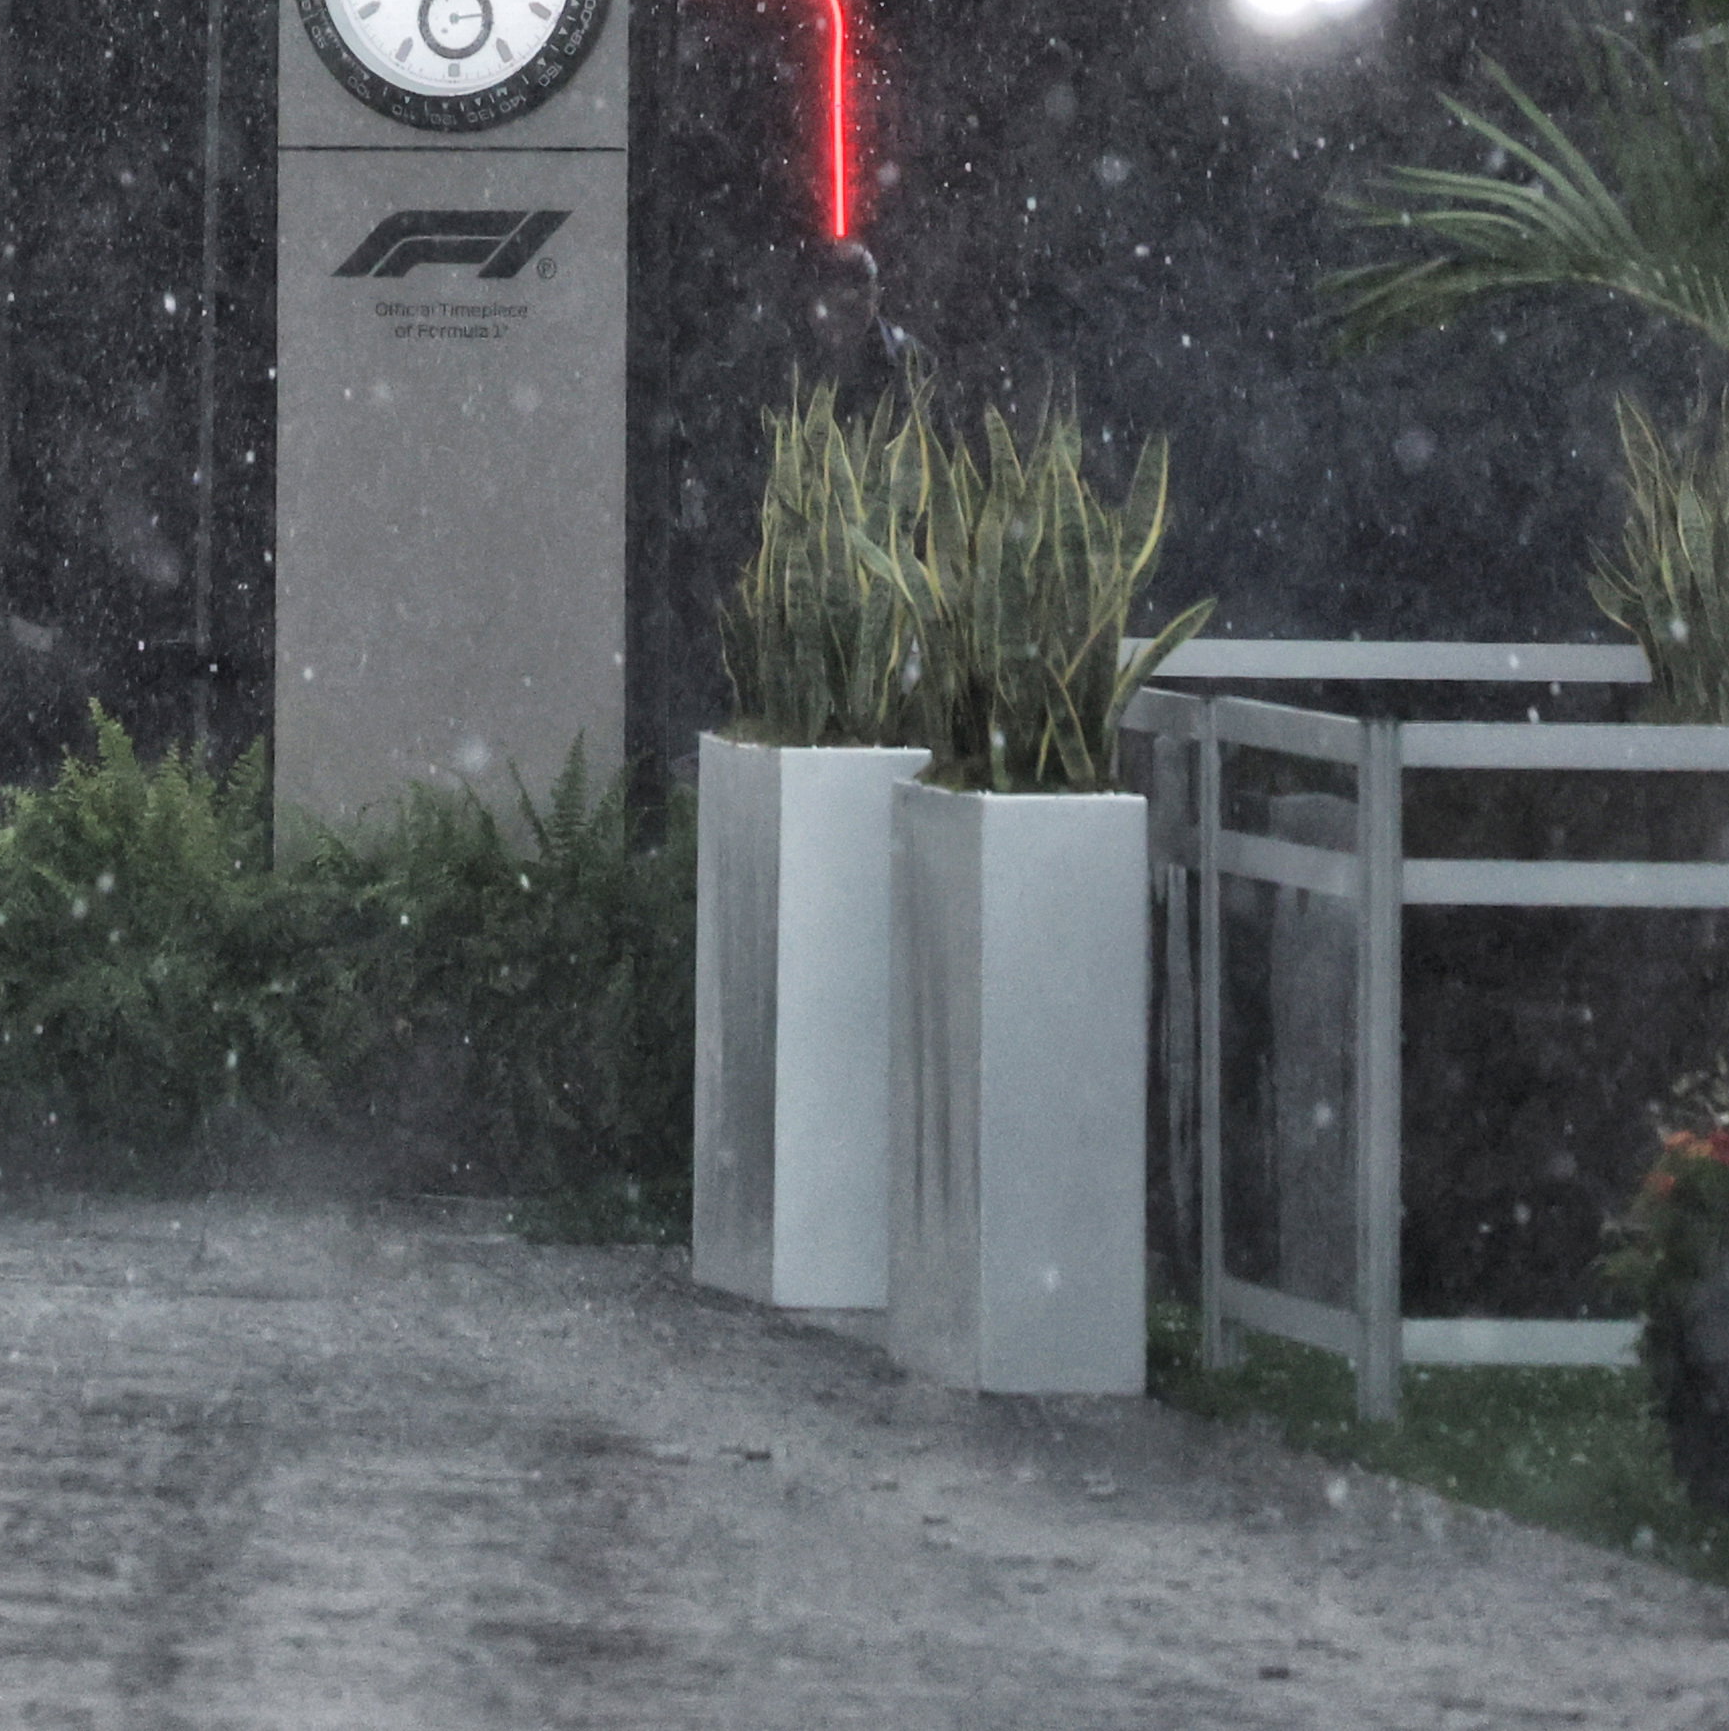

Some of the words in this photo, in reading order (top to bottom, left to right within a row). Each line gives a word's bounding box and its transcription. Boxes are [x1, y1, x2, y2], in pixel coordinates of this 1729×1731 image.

[538, 61, 563, 87] 160
[438, 301, 529, 321] Timepiece
[394, 324, 414, 339] of
[417, 324, 489, 339] Formula
